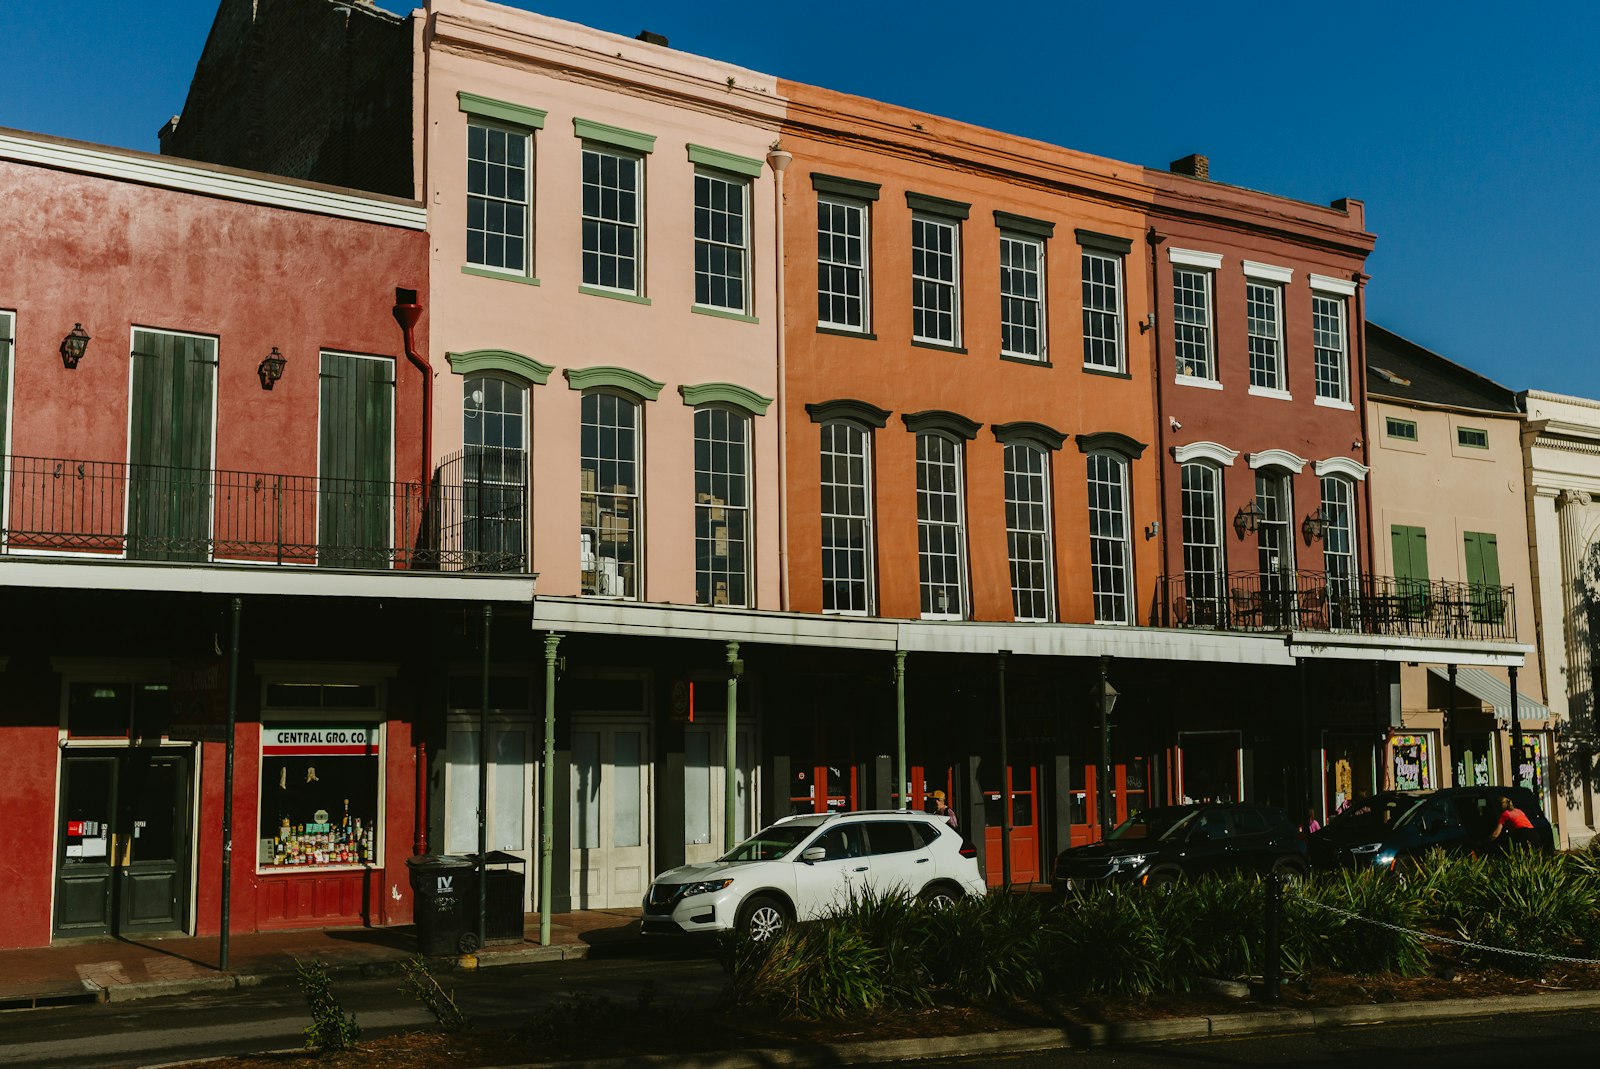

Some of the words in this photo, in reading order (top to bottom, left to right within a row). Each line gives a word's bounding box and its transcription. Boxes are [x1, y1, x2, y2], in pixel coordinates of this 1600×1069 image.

[277, 732, 323, 743] CENTRAL
[325, 732, 348, 743] GRO.
[350, 732, 366, 743] CO.
[437, 876, 453, 888] IV
